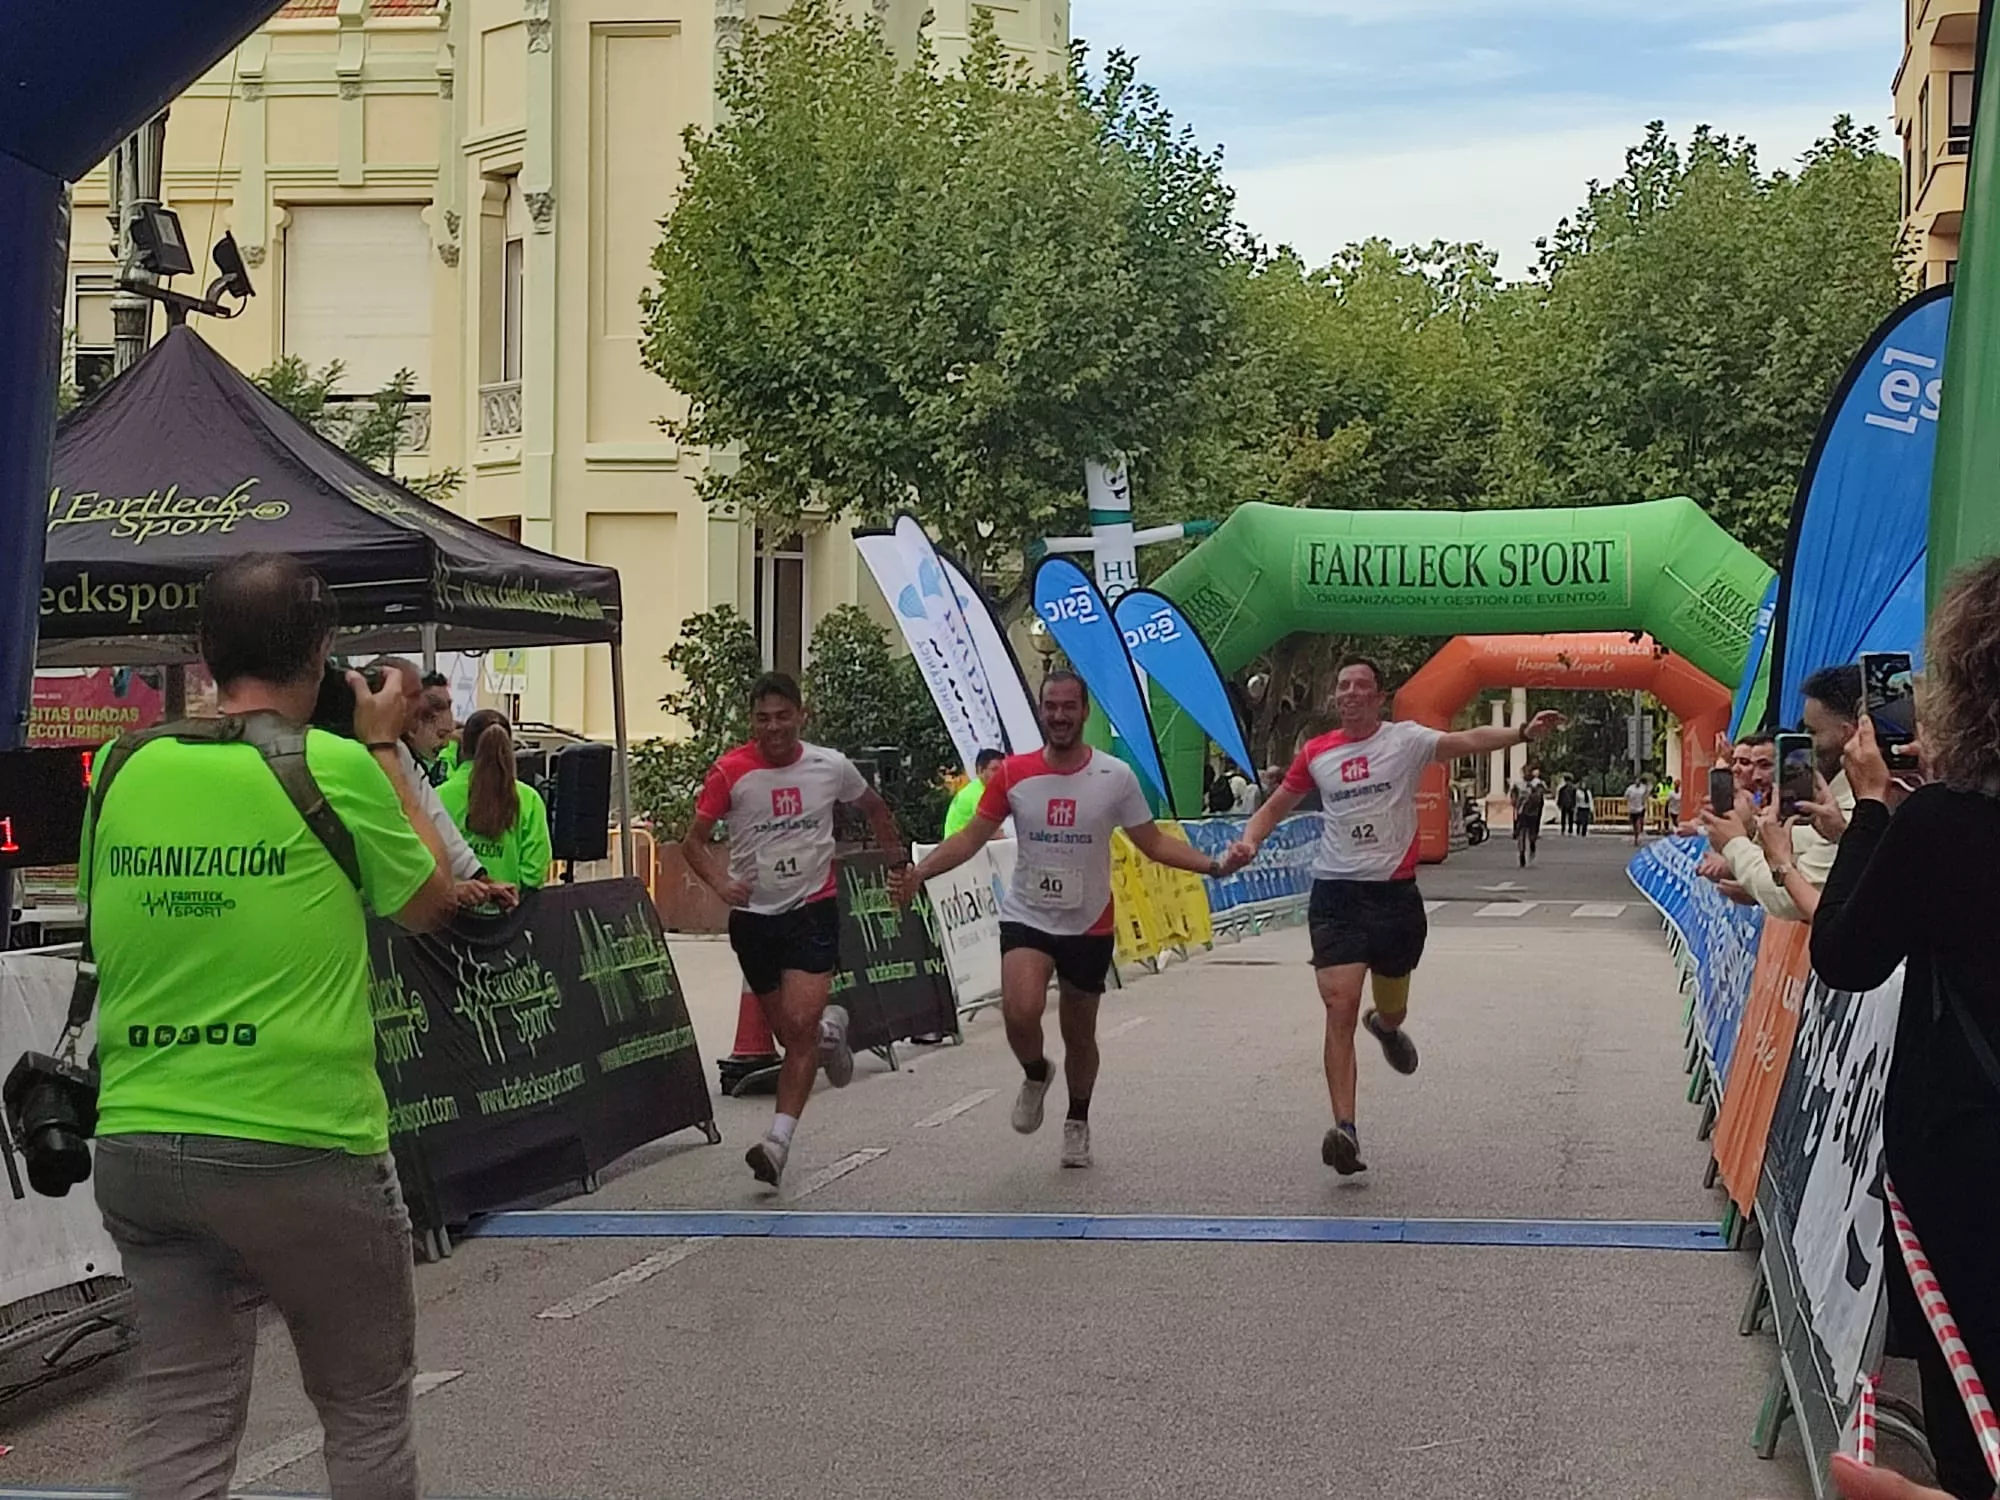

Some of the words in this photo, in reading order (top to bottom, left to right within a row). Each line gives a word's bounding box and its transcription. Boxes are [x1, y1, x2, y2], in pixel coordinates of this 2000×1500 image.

[65, 478, 260, 521] Fartleck
[110, 511, 238, 545] Sport
[1308, 543, 1489, 588] FARTLECK
[1499, 540, 1615, 588] SPORT
[1430, 595, 1441, 606] Y
[1513, 594, 1532, 606] DE
[1537, 592, 1607, 605] EVENTOS
[1600, 642, 1650, 656] Huesca
[74, 706, 140, 723] GUIADAS
[28, 723, 125, 740] ECOTURISMO
[1028, 829, 1093, 844] salesianos
[1351, 823, 1375, 840] 42
[110, 839, 287, 876] ORGANIZACIÓN
[774, 856, 796, 873] 41
[1039, 875, 1063, 893] 40
[172, 890, 224, 902] FARTLECK
[174, 906, 223, 918] SPORT
